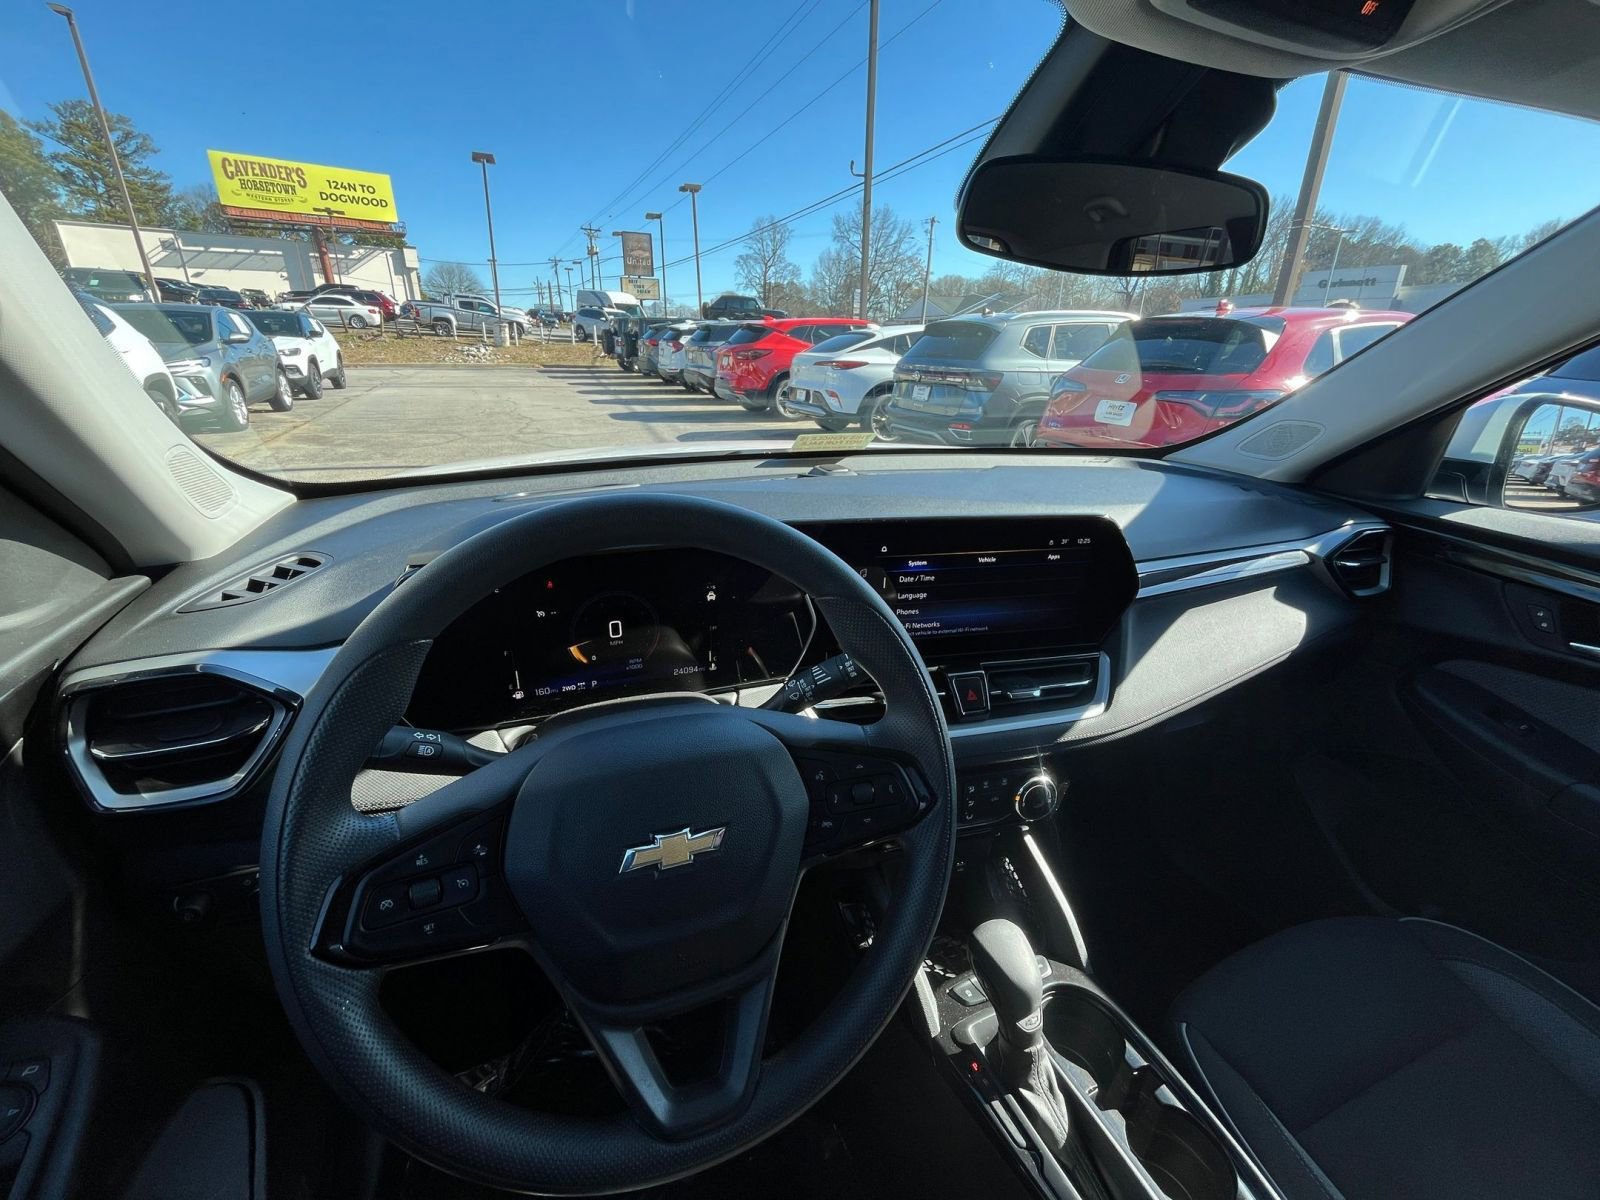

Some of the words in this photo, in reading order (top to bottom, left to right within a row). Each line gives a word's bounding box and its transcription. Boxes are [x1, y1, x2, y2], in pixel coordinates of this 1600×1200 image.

[1361, 1, 1379, 15] OFF
[221, 157, 308, 189] CAVENDER'S
[238, 178, 297, 196] HORSETOWN
[326, 180, 358, 193] 124N
[359, 184, 376, 194] TO
[319, 191, 388, 208] DOGWOOD
[626, 256, 652, 266] United
[897, 592, 928, 600] Language
[608, 620, 622, 638] 0
[674, 666, 698, 676] 24094
[535, 687, 550, 696] 160
[416, 858, 428, 866] RES
[424, 922, 434, 932] SET
